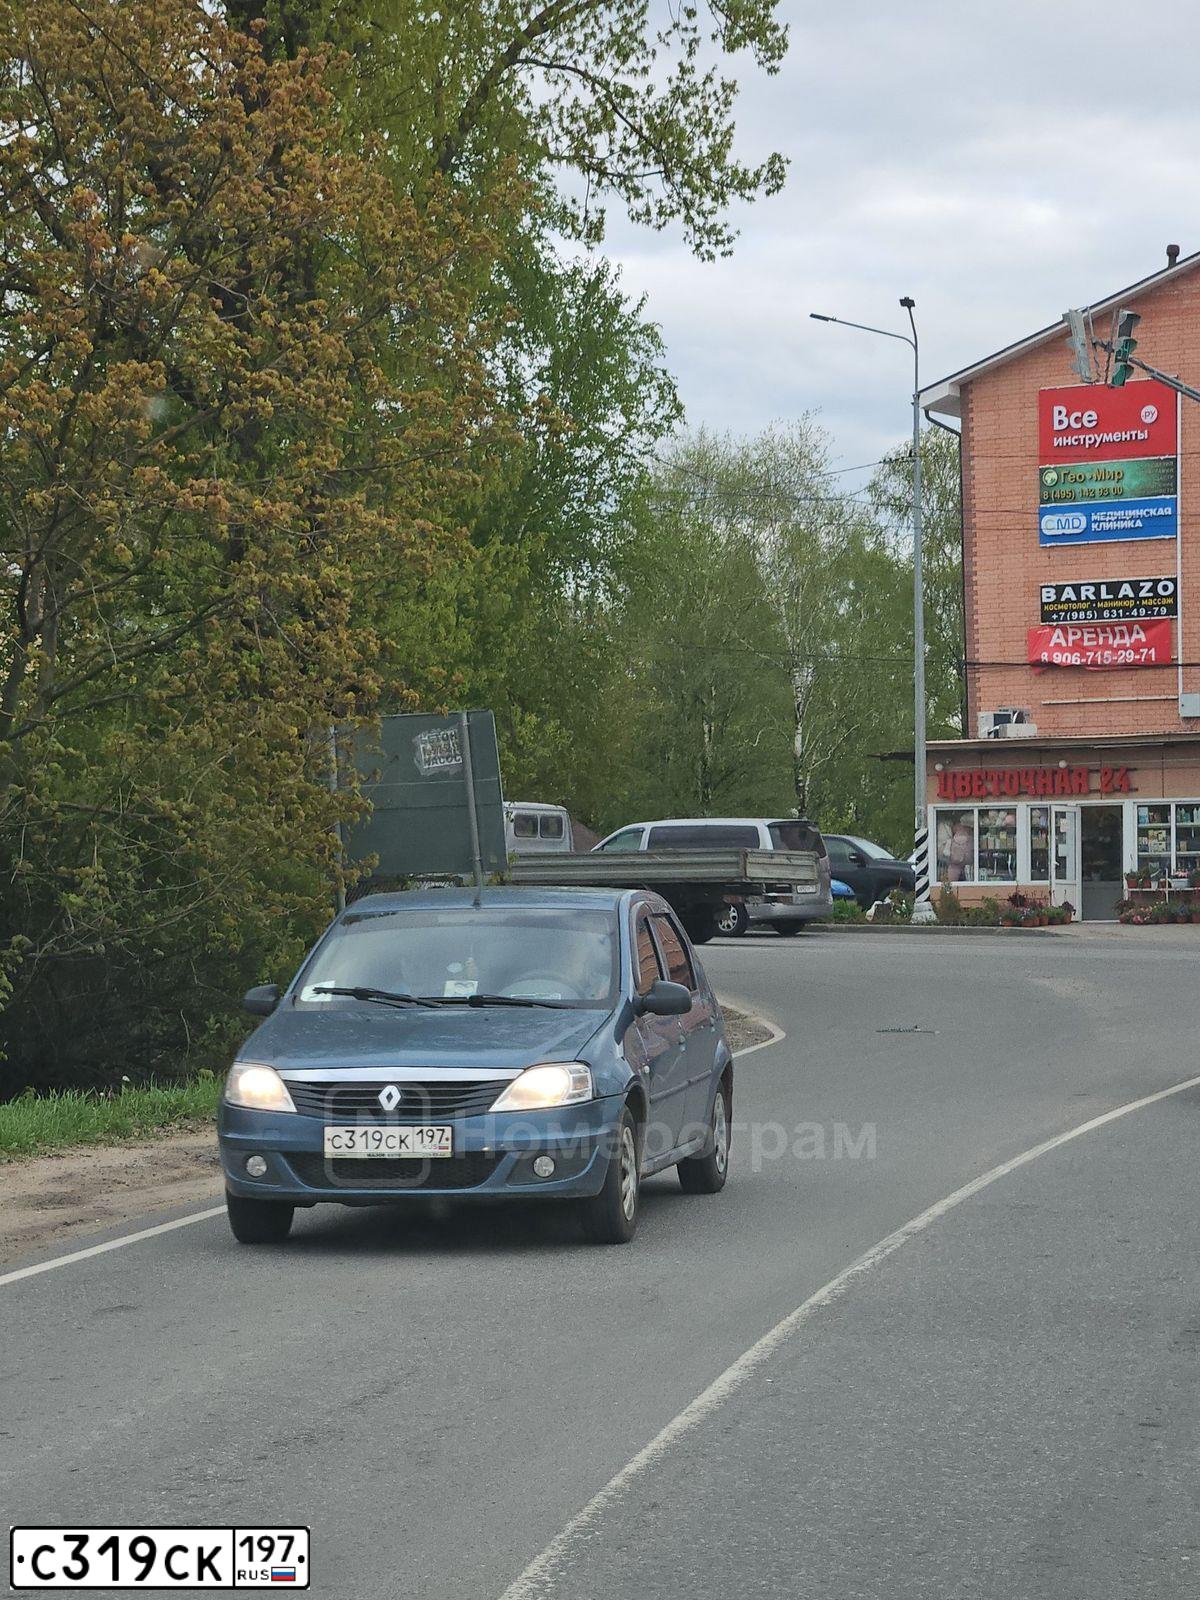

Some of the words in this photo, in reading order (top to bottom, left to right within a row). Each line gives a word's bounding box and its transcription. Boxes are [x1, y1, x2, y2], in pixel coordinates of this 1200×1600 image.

[1053, 405, 1098, 431] Все
[1053, 429, 1148, 448] инструменты
[1042, 491, 1049, 500] 8
[1051, 488, 1075, 500] (495)
[1091, 507, 1172, 521] МЕДИЦИНСКАЯ
[1091, 521, 1143, 532] КЛИНИКА
[1041, 580, 1175, 603] BARLAZO
[1044, 602, 1090, 611] косметолог
[1097, 599, 1134, 608] маникюр
[1141, 597, 1174, 606] массаж
[1103, 606, 1167, 618] 631-49-79
[1049, 624, 1146, 648] АРЕНДА
[937, 767, 1089, 800] ЦВЕТОЧНАЯ
[1101, 766, 1130, 793] 24
[416, 1128, 445, 1143] 197
